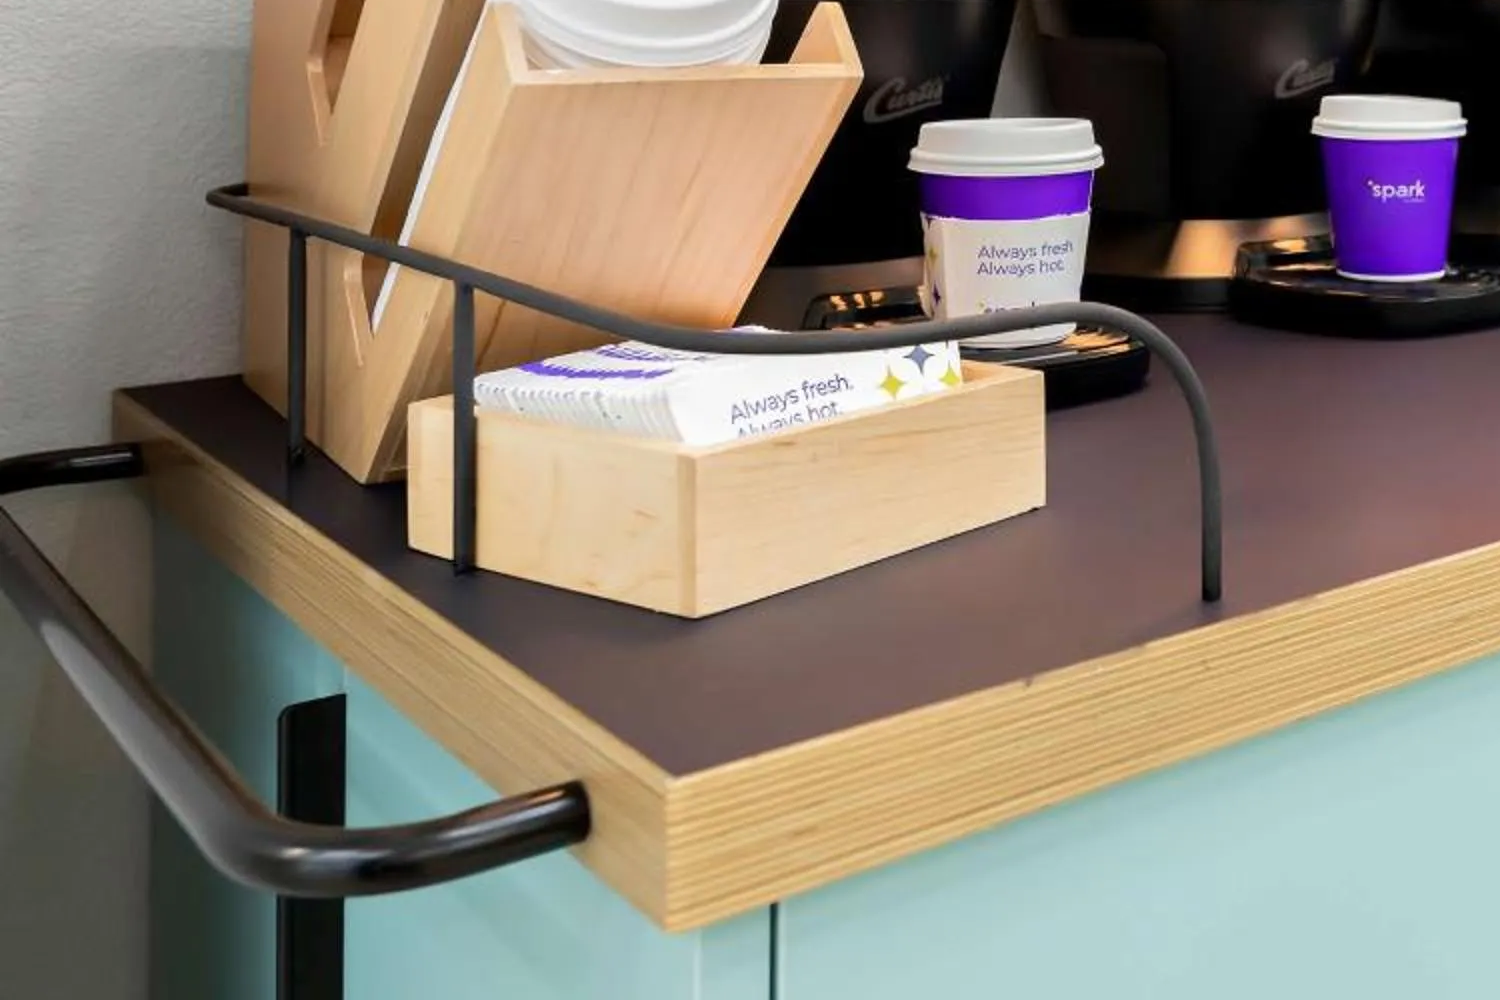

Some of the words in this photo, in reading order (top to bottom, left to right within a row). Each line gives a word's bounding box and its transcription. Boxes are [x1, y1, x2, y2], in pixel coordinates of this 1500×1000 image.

[1371, 179, 1425, 203] spark
[977, 245, 1037, 261] Always
[977, 261, 1036, 277] Always
[730, 389, 800, 425] Always
[801, 373, 854, 401] fresh.
